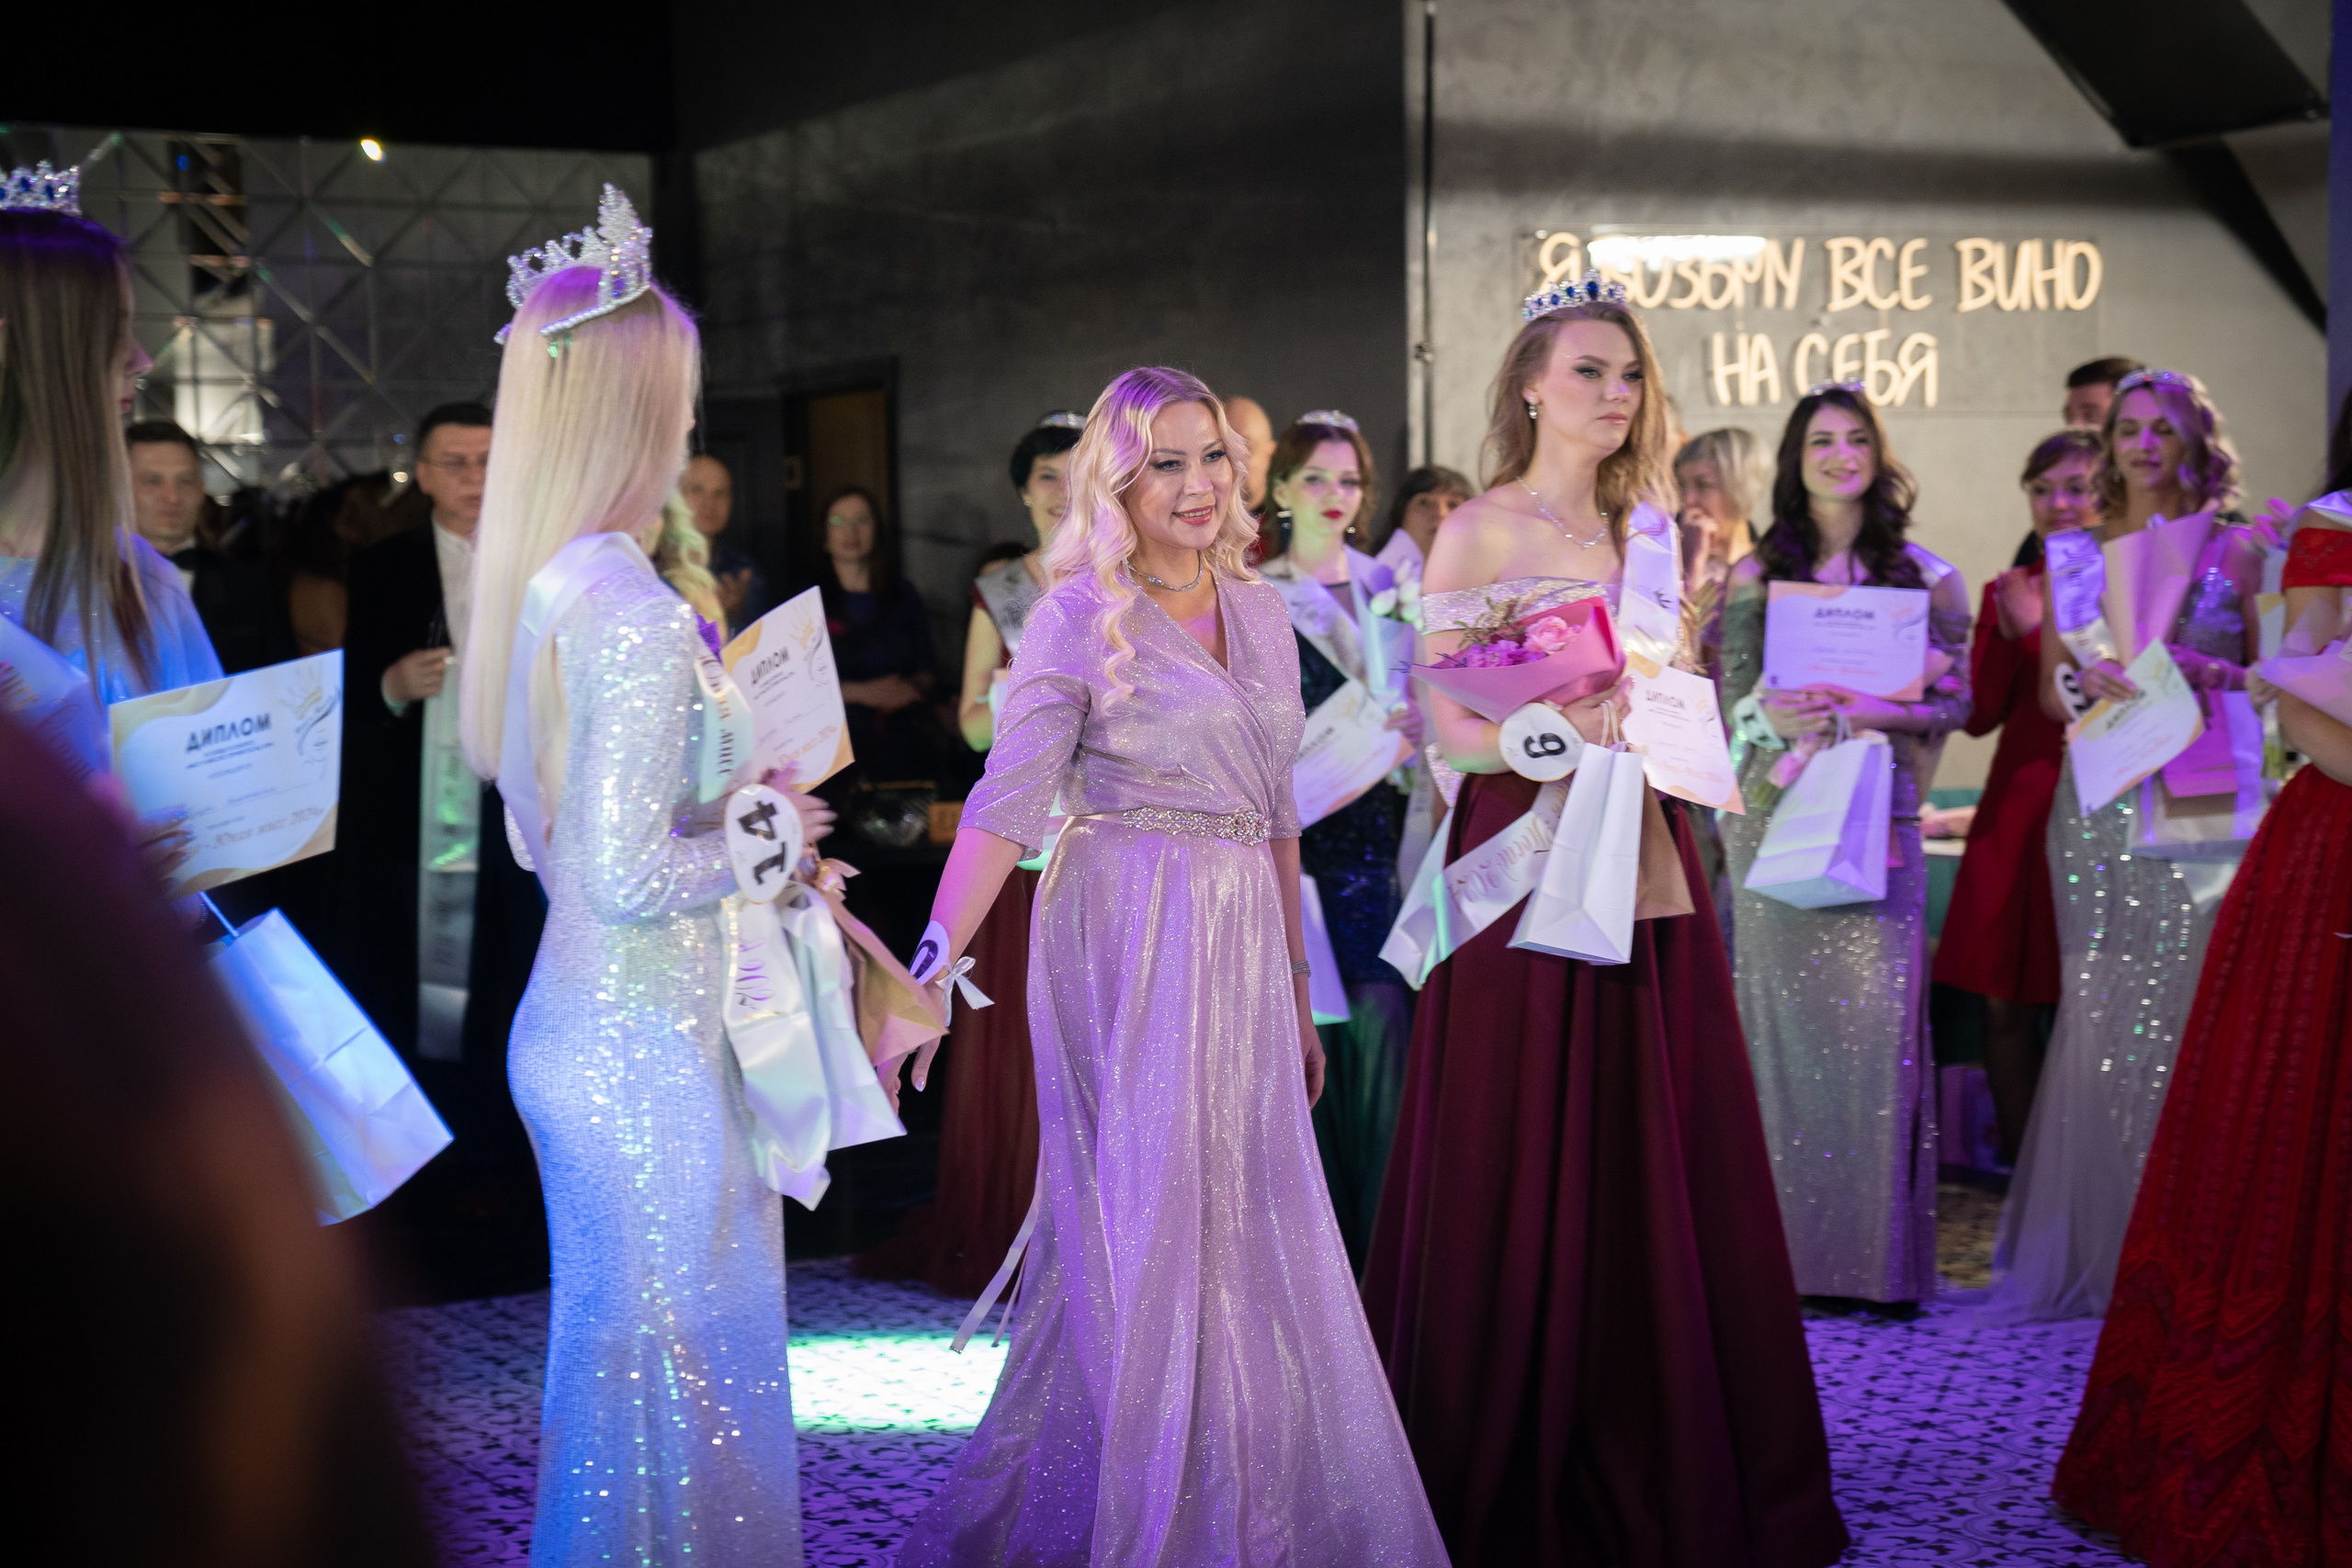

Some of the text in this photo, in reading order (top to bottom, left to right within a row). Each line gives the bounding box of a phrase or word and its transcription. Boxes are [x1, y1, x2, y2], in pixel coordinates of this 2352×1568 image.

[1539, 232, 2103, 312] Я ОЗЬМУ ВСЕ ВИНО
[1713, 328, 1938, 407] НА СЕБЯ
[186, 713, 272, 752] ДИПЛОМ
[736, 800, 788, 886] 14
